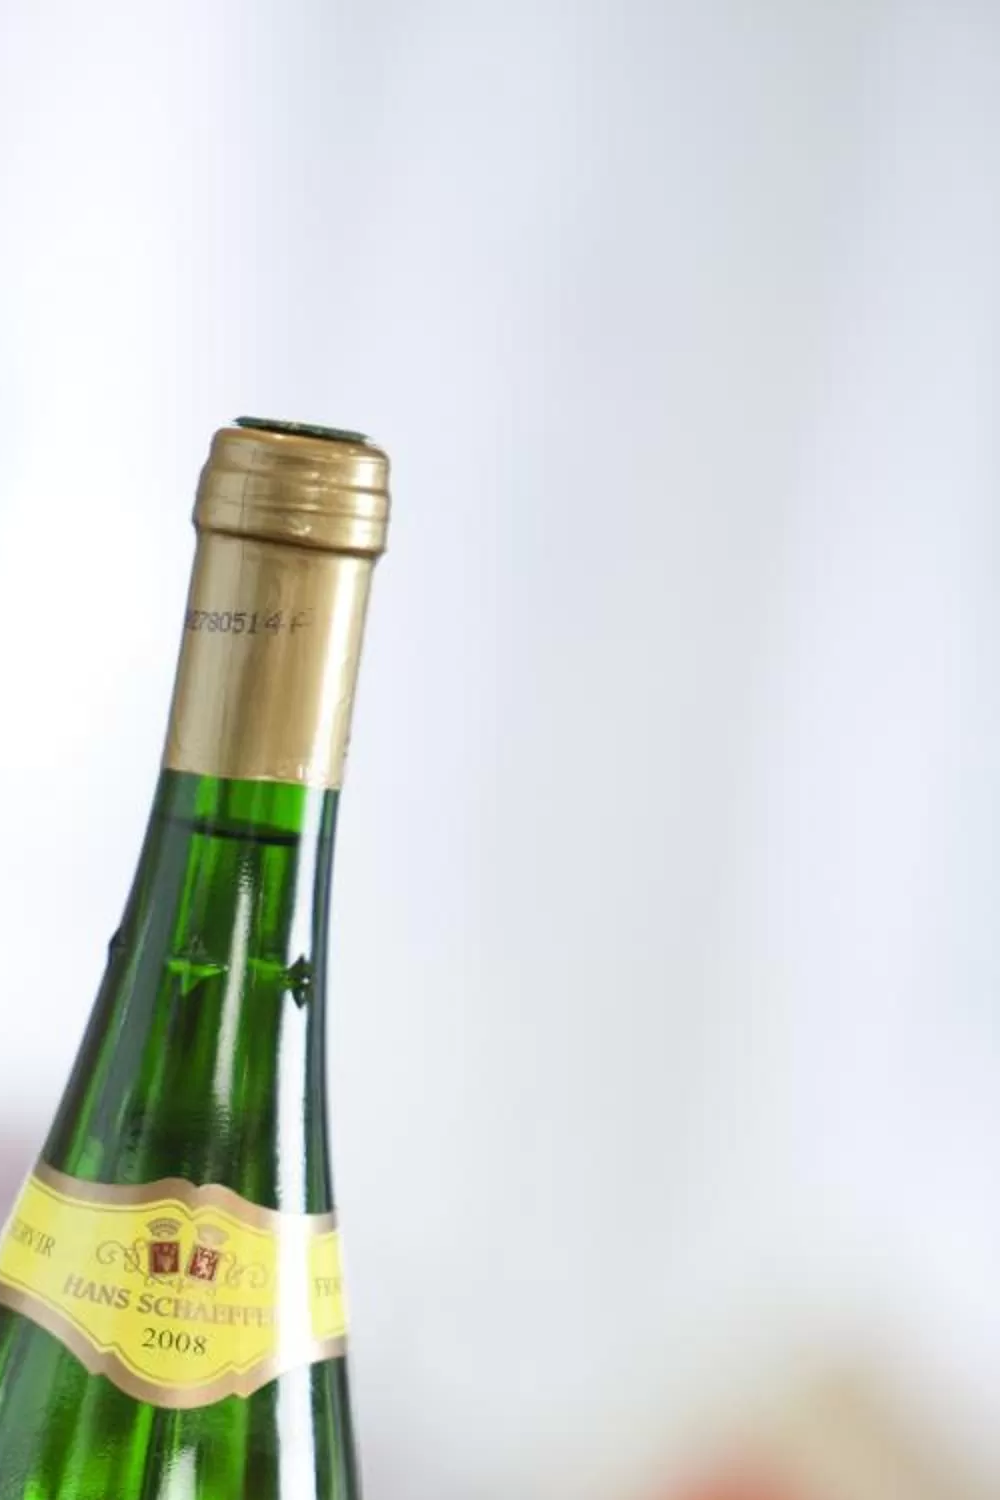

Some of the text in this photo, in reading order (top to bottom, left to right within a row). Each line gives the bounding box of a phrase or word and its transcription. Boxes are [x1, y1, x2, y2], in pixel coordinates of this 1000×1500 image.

[63, 1273, 280, 1328] HANS SCHAEFFE
[141, 1327, 208, 1356] 2008
